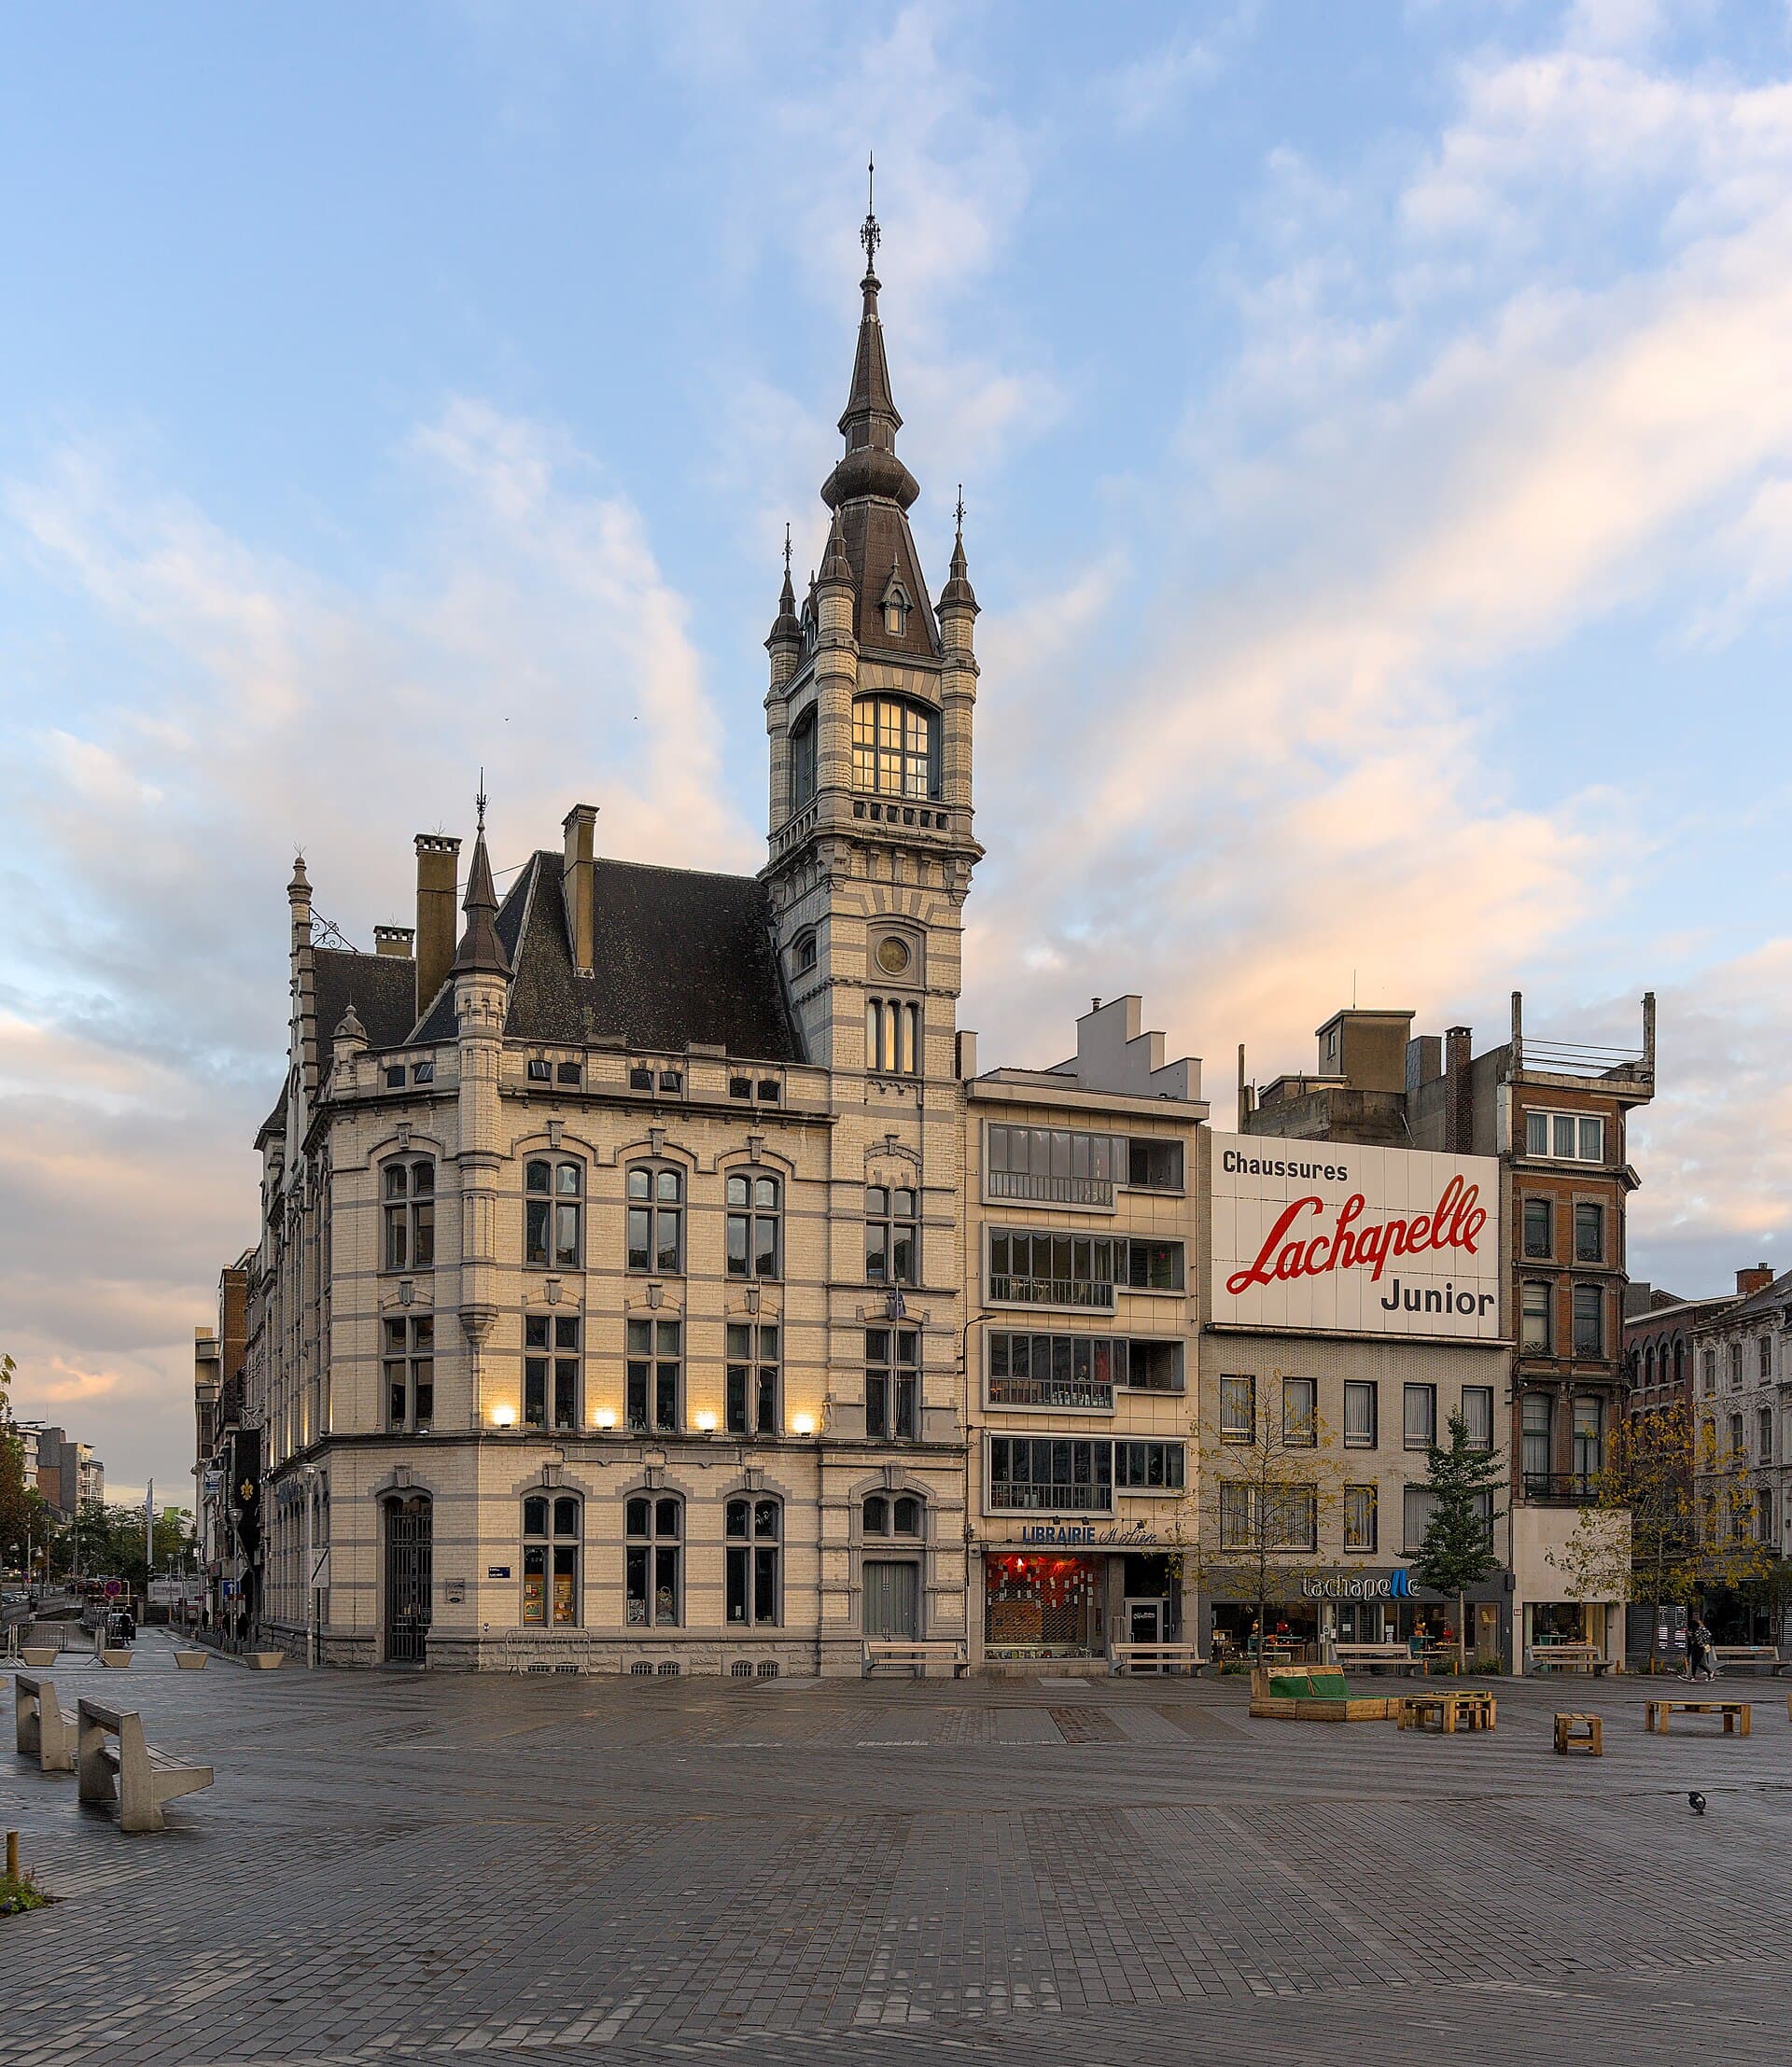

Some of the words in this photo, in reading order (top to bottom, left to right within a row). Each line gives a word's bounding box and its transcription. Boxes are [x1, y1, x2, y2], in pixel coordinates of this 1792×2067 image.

[1223, 1150, 1348, 1181] Chaussures
[1225, 1174, 1487, 1295] Lachapelle
[1380, 1278, 1495, 1317] Junior
[1023, 1526, 1096, 1543] LIBRAIRIE
